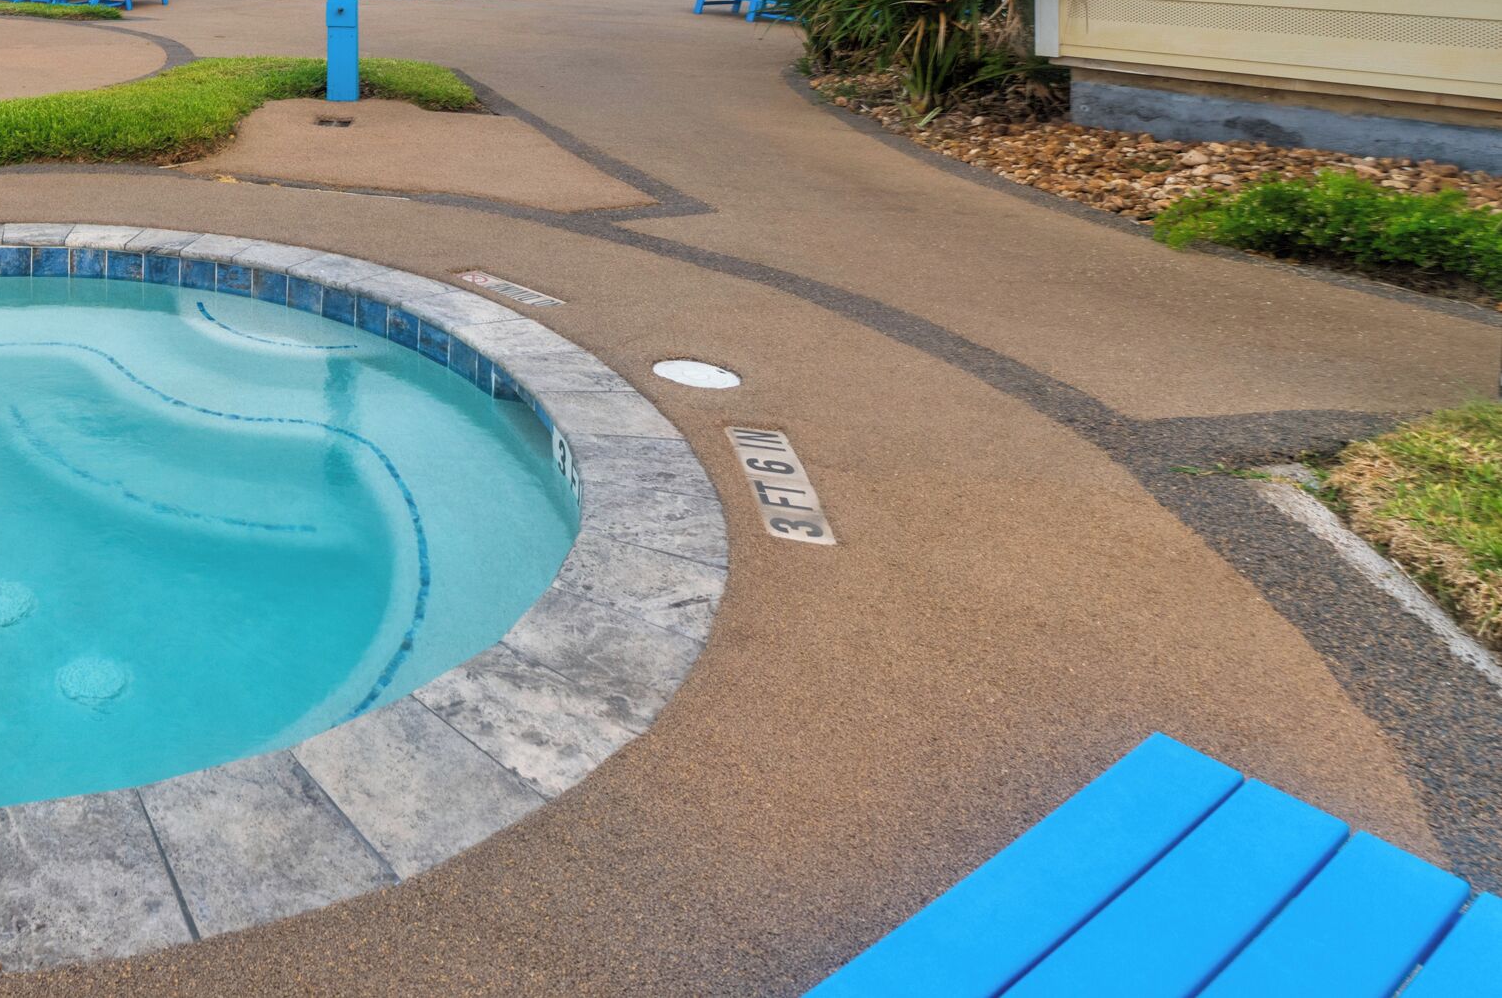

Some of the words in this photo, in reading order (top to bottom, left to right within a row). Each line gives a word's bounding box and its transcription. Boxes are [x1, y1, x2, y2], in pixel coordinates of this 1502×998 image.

[733, 429, 787, 452] IN
[558, 439, 567, 477] 3
[746, 458, 795, 475] 6
[753, 479, 814, 512] FT
[769, 517, 824, 538] 3
